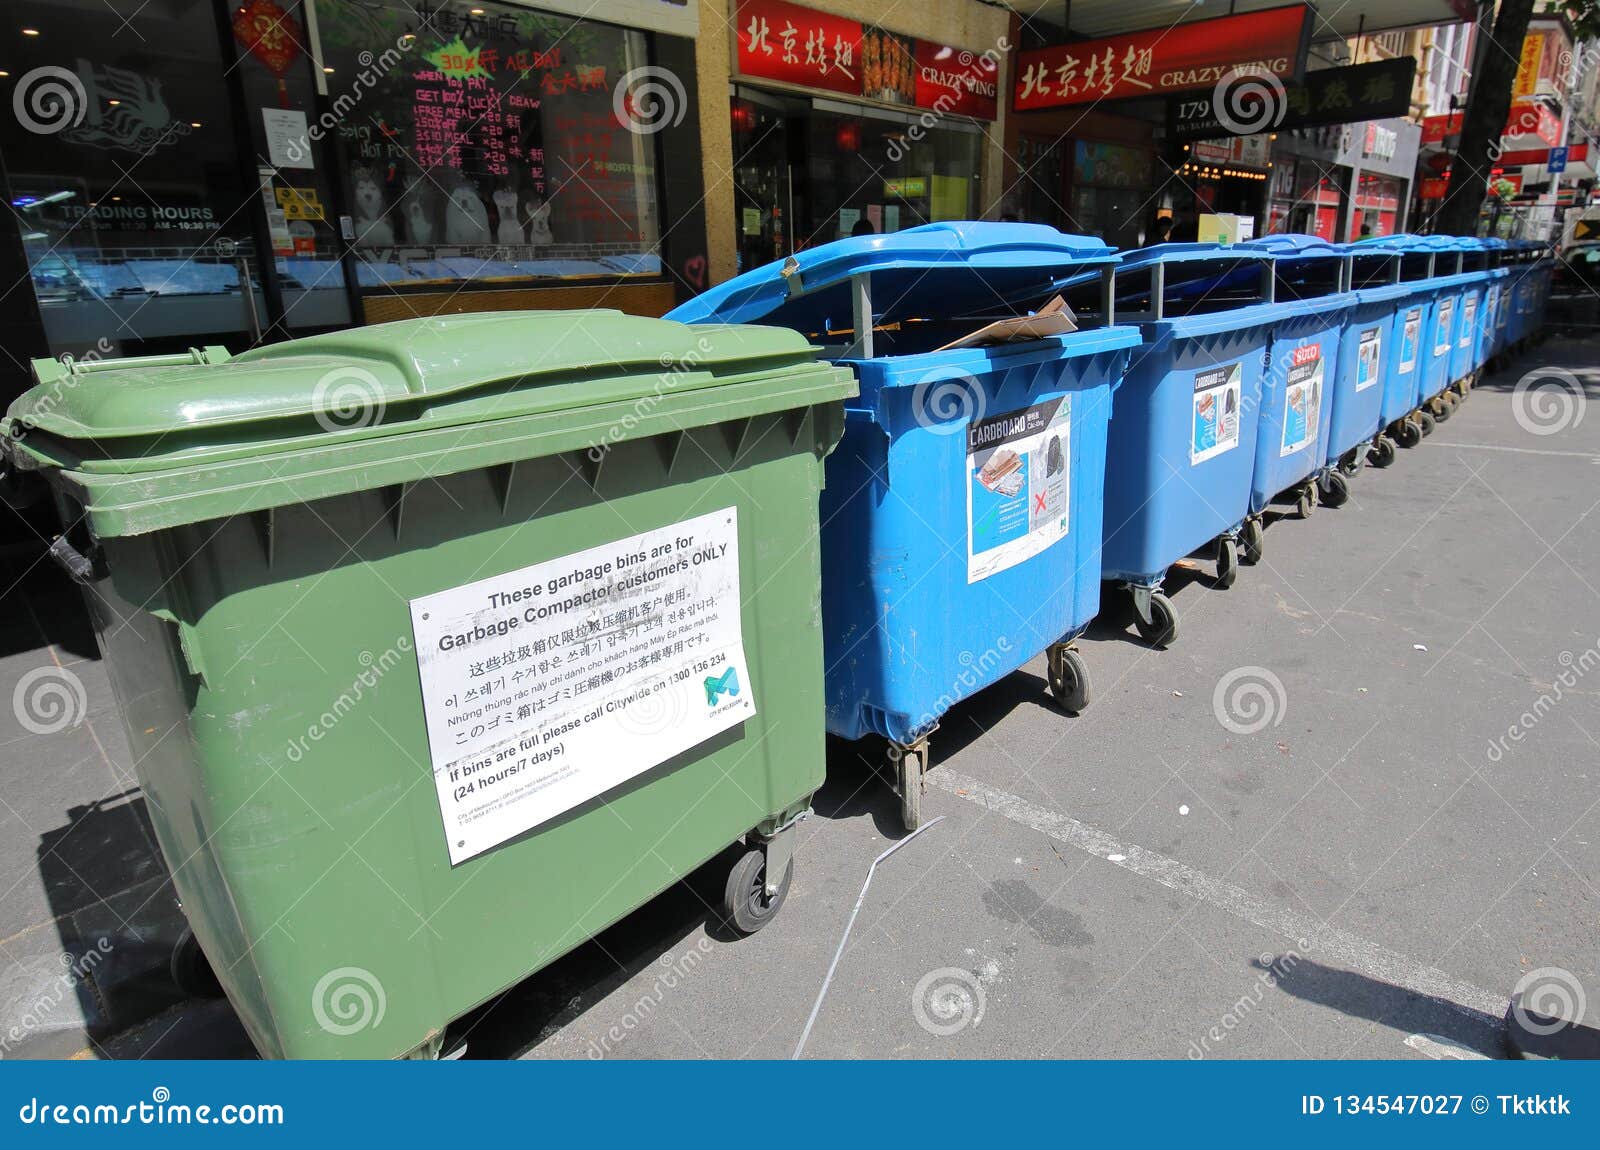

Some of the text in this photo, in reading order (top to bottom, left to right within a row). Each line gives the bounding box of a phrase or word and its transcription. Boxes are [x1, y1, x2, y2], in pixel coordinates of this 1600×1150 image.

[922, 66, 996, 97] CRAZY WING
[1160, 57, 1288, 87] CRAZY WING
[416, 89, 440, 102] GET
[1178, 100, 1210, 119] 179
[446, 106, 478, 120] MEAL
[360, 142, 381, 158] HOT
[60, 205, 213, 220] TRADING HOURS
[154, 222, 170, 230] AM
[970, 415, 1026, 446] CARDBOARD
[488, 535, 694, 609] These garbage bins are for
[439, 542, 728, 651] Garbage Compactor customers ONLY
[445, 694, 458, 708] 이
[464, 676, 505, 703] 쓰레기
[511, 656, 563, 684] 수거함은
[567, 639, 601, 664] 쓰레기
[587, 658, 603, 671] cho
[450, 652, 726, 783] If bins are full please call Citywide on 1300 136 234
[454, 782, 475, 802] (24
[478, 758, 527, 790] hours/7
[531, 742, 565, 766] days)
